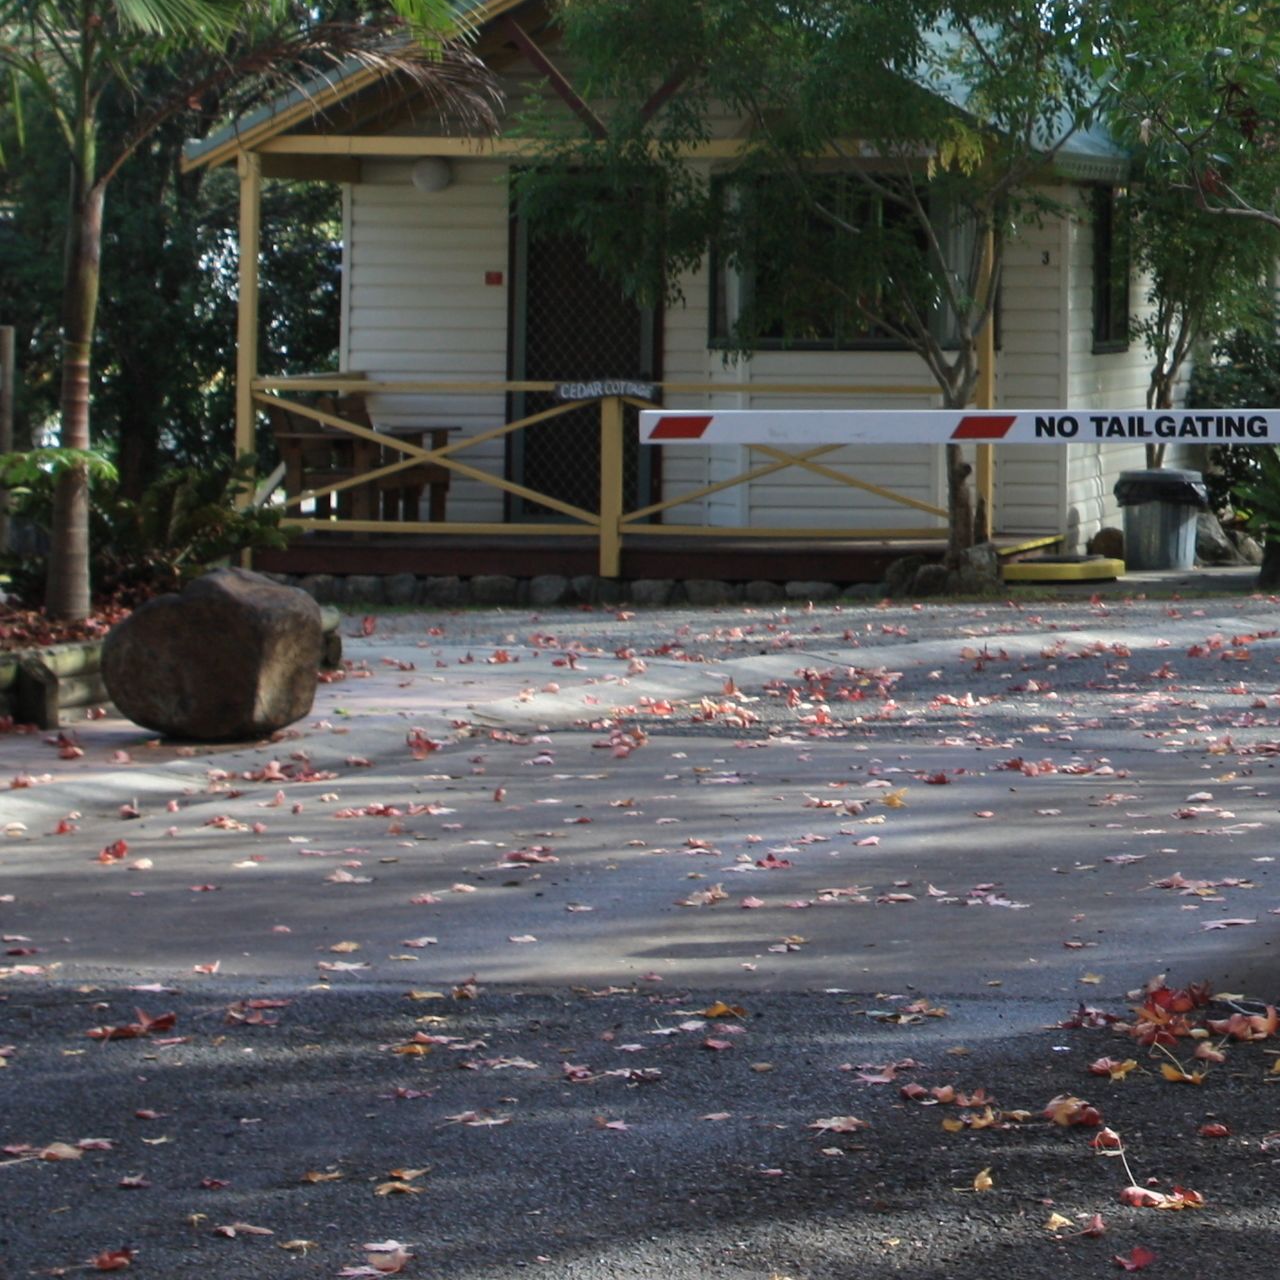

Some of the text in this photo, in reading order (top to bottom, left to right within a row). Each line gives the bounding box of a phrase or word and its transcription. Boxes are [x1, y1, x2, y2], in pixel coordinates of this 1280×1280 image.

[1041, 250, 1050, 265] 3
[560, 381, 602, 399] CEDAR
[1034, 416, 1269, 438] NO TAILGATING
